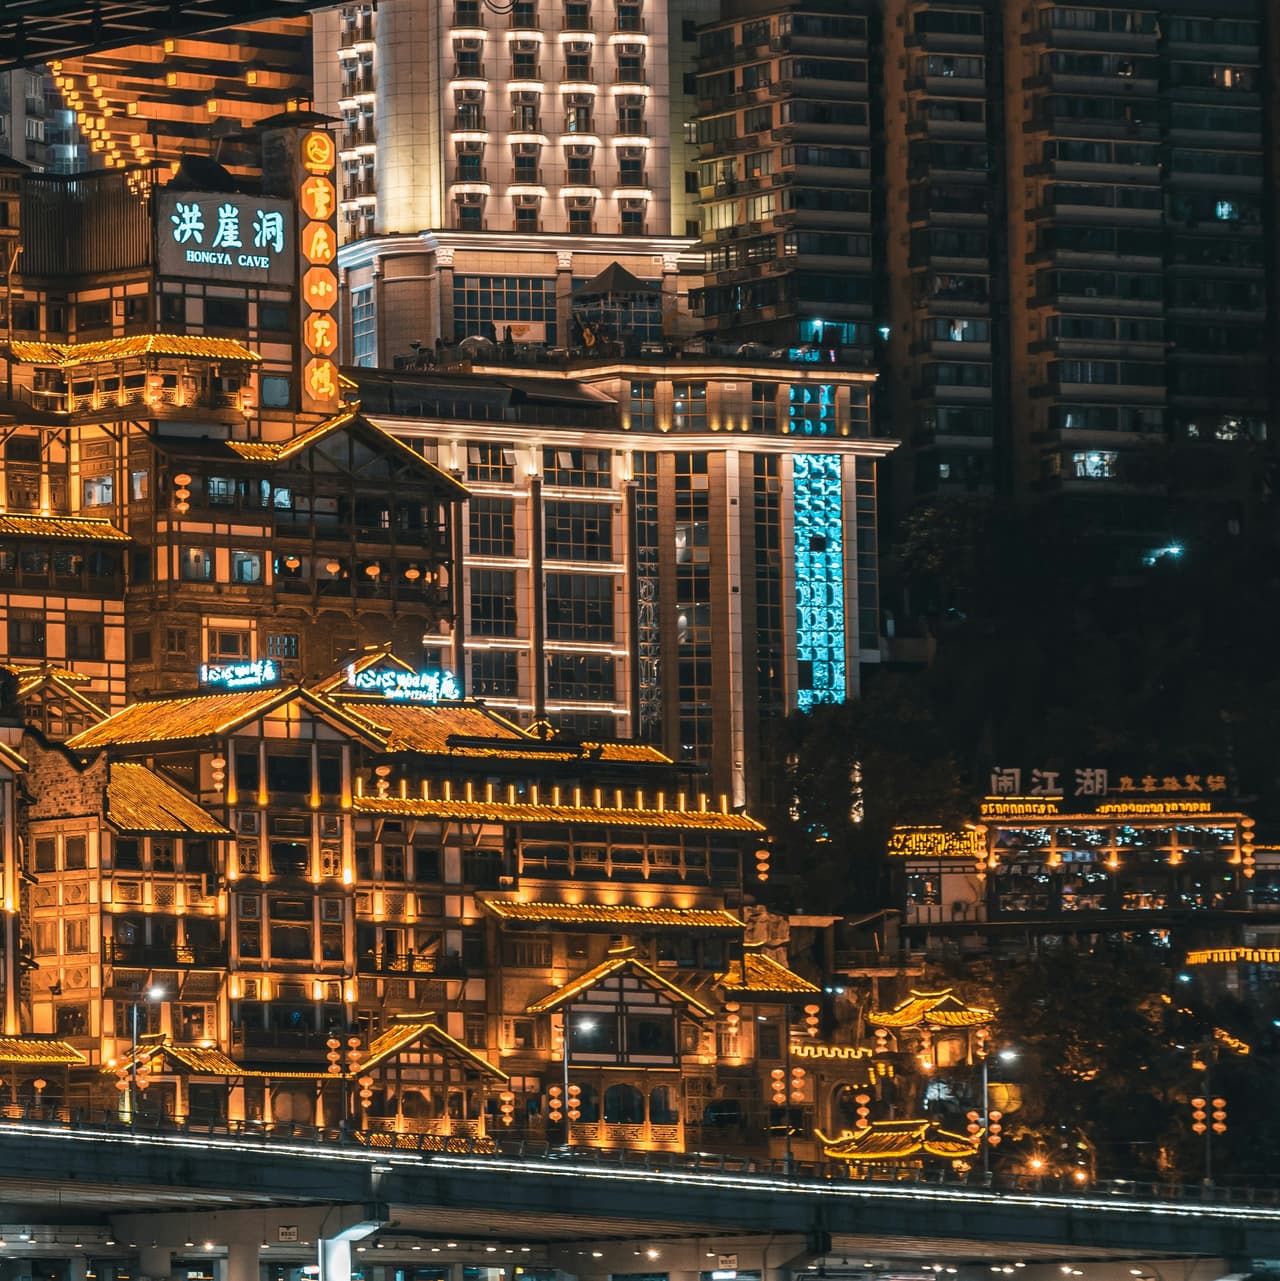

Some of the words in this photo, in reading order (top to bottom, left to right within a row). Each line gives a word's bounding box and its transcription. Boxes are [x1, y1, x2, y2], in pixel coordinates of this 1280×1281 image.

[170, 201, 285, 254] 洪崖洞
[186, 250, 233, 266] HONGYA
[238, 255, 269, 269] CAVE
[990, 768, 1108, 796] 闹江湖
